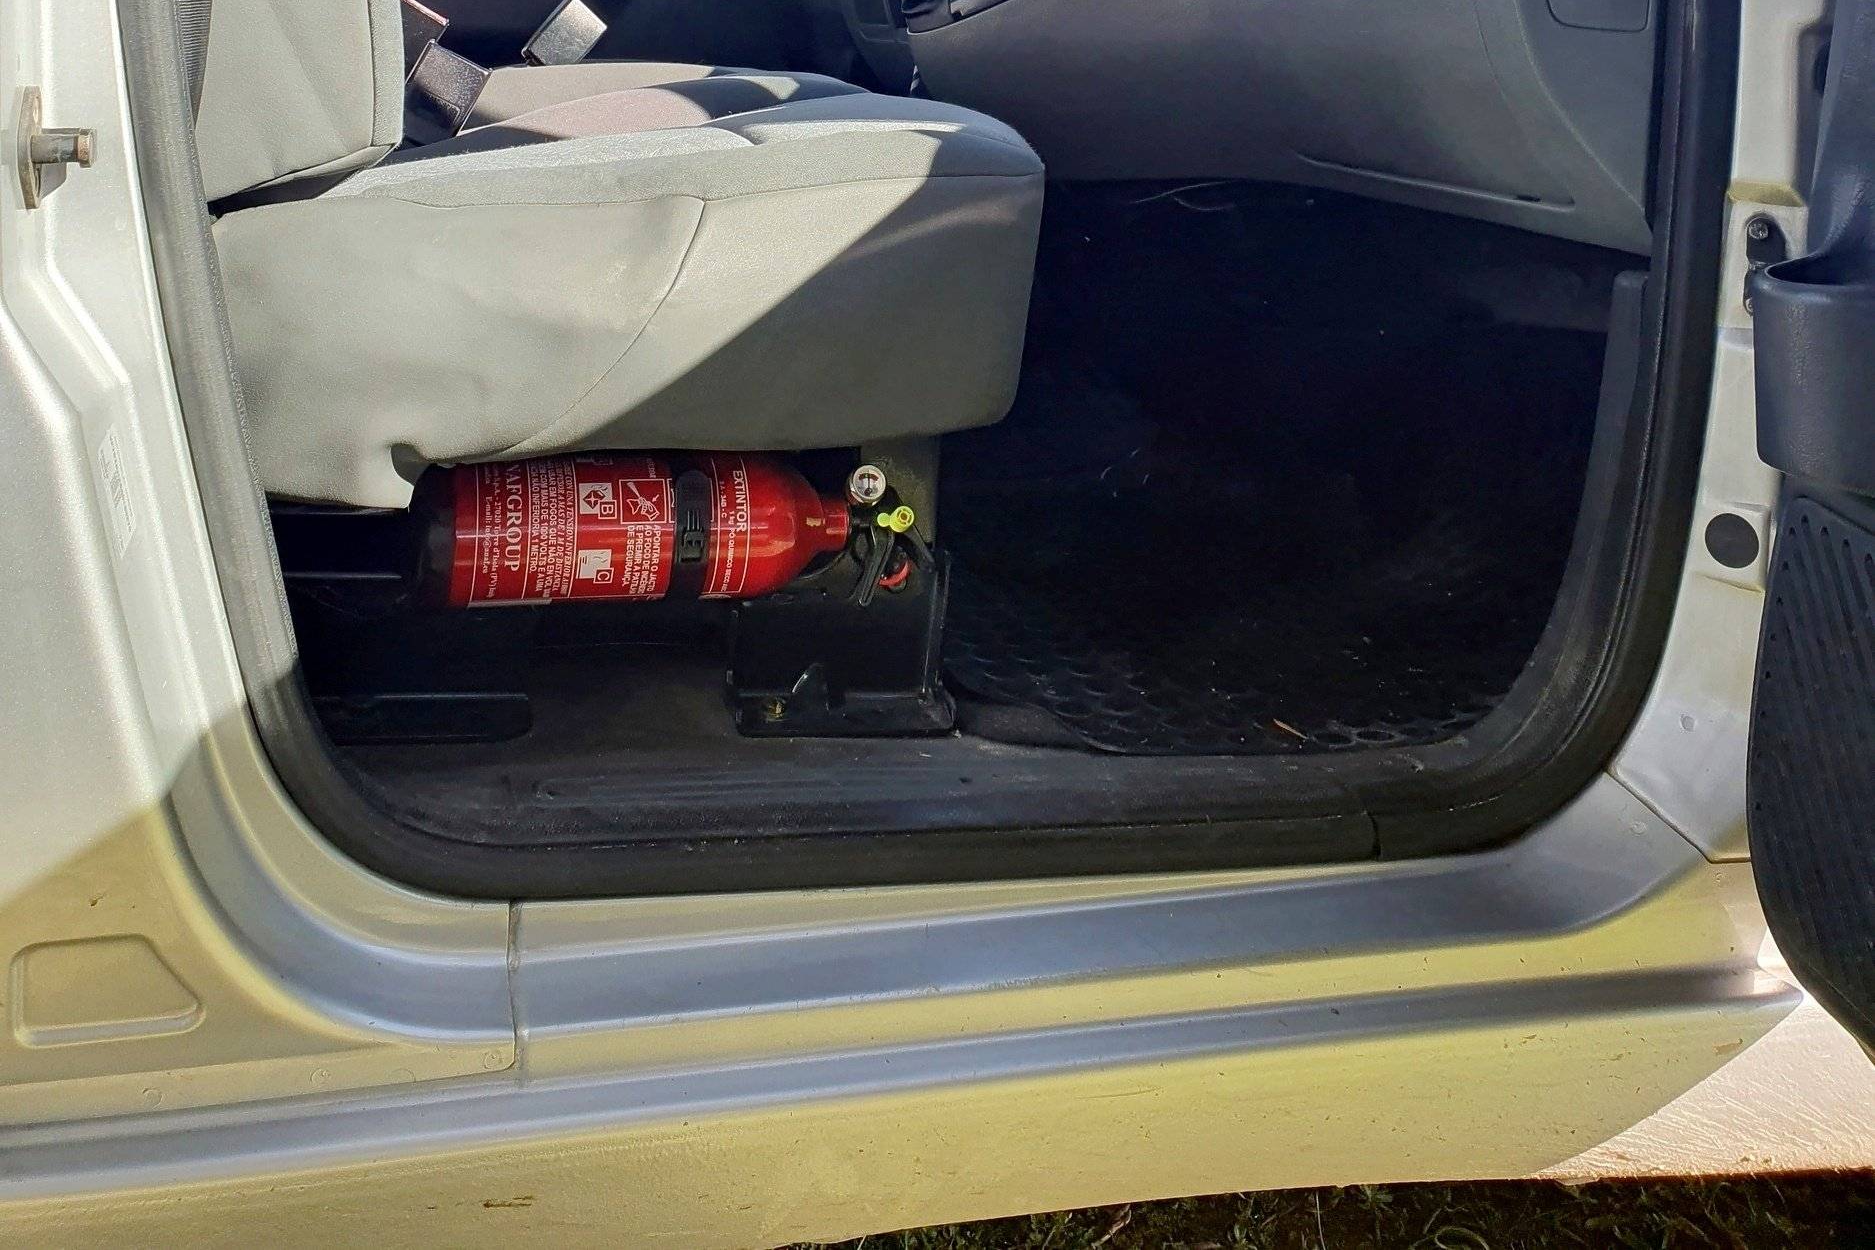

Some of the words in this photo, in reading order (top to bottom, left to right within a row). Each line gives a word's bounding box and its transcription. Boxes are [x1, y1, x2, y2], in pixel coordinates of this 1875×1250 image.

[540, 489, 549, 507] MAIS
[549, 486, 557, 497] EM
[566, 490, 574, 506] UNA
[557, 501, 565, 517] MAS
[732, 470, 747, 532] EXTINTOR
[541, 509, 549, 520] DE
[549, 498, 557, 525] FOGOS
[601, 505, 613, 514] B
[540, 522, 549, 539] 1000
[557, 518, 565, 530] DE
[565, 507, 574, 541] TENSION
[627, 525, 635, 538] DE
[644, 525, 653, 536] AO
[548, 527, 557, 545] QUE
[555, 546, 564, 557] DE
[634, 532, 644, 564] PREMIR
[643, 538, 652, 559] FOCO
[652, 525, 662, 564] APONTAR
[538, 540, 548, 566] VOLTS
[547, 547, 557, 563] NÃO
[562, 542, 573, 577] INFERIOR
[642, 560, 650, 570] DE
[598, 572, 609, 580] C
[647, 573, 657, 592] JACTO
